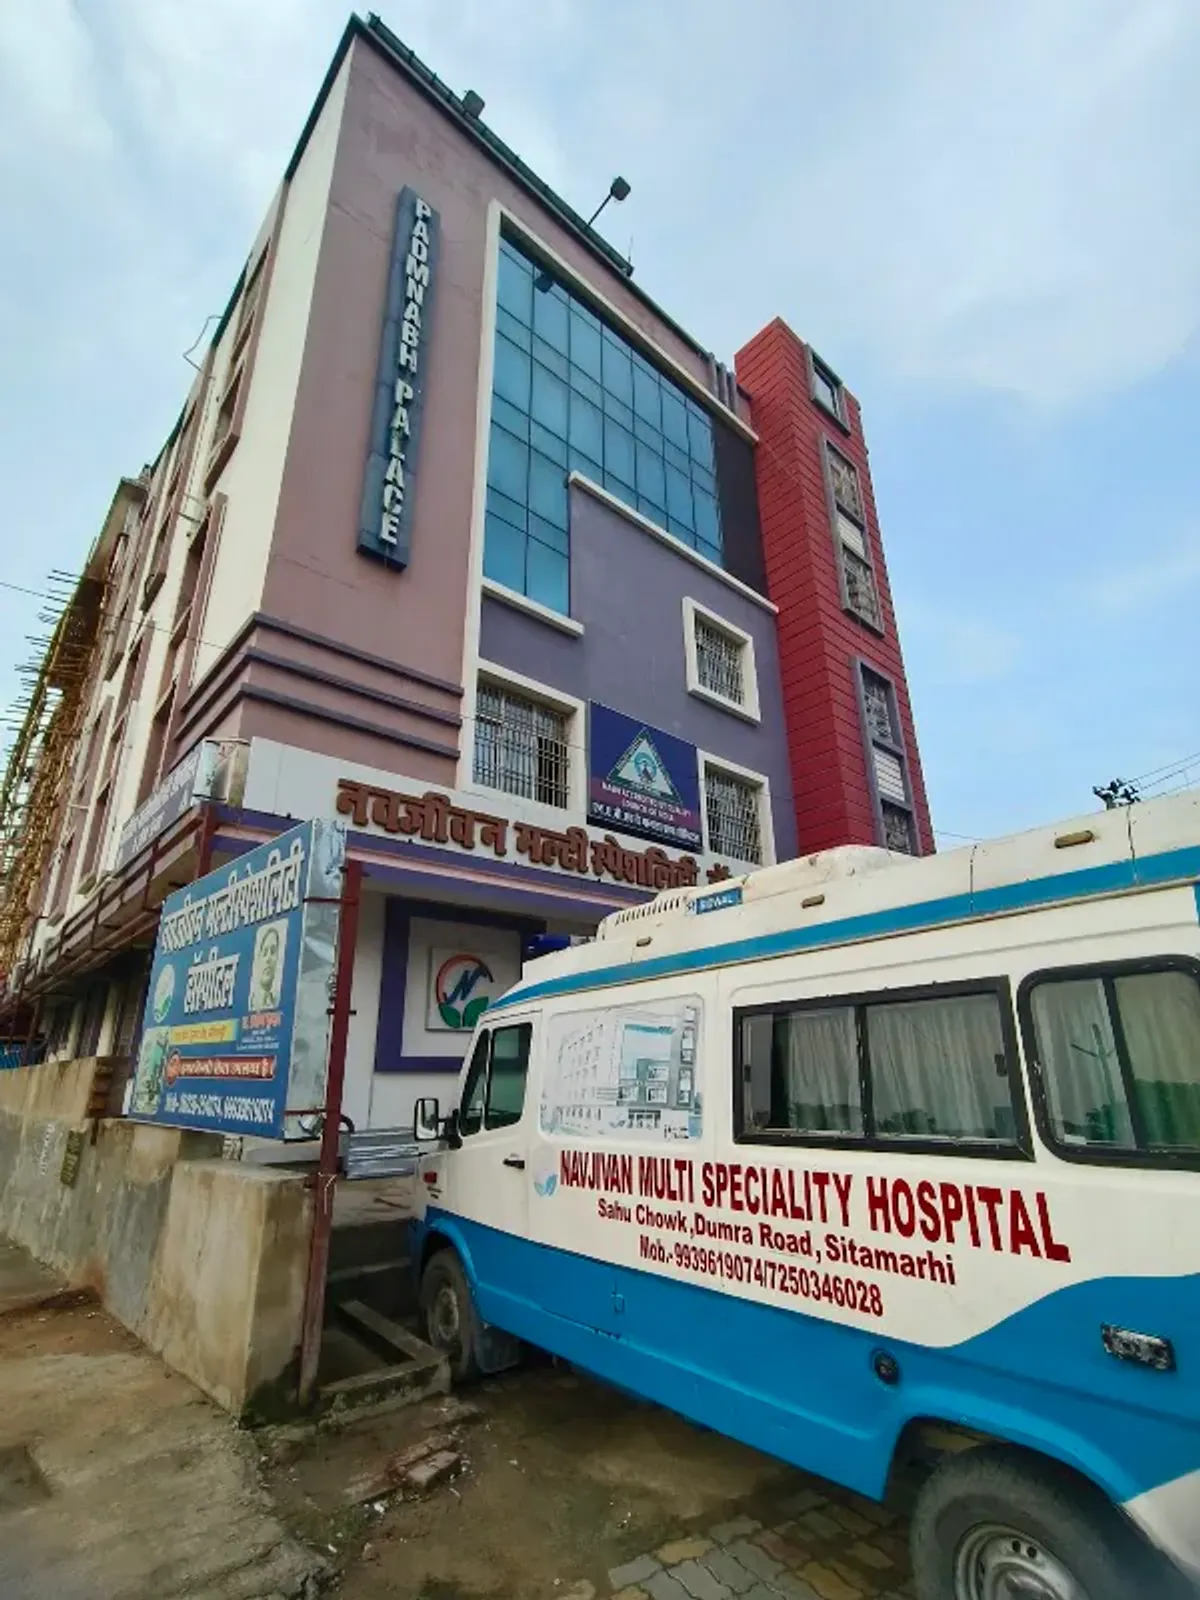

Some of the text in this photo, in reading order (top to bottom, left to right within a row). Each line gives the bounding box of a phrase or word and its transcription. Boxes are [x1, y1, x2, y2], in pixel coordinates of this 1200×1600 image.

[380, 198, 432, 545] PADMNABH PALACE
[336, 778, 509, 857] नवजीवन
[513, 821, 589, 875] मल्टी
[560, 1150, 1072, 1263] NAVJIVAN MULTI SPECIALITY HOSPITAL
[598, 1198, 632, 1223] Sahu
[825, 1233, 956, 1286] Sitamarhi
